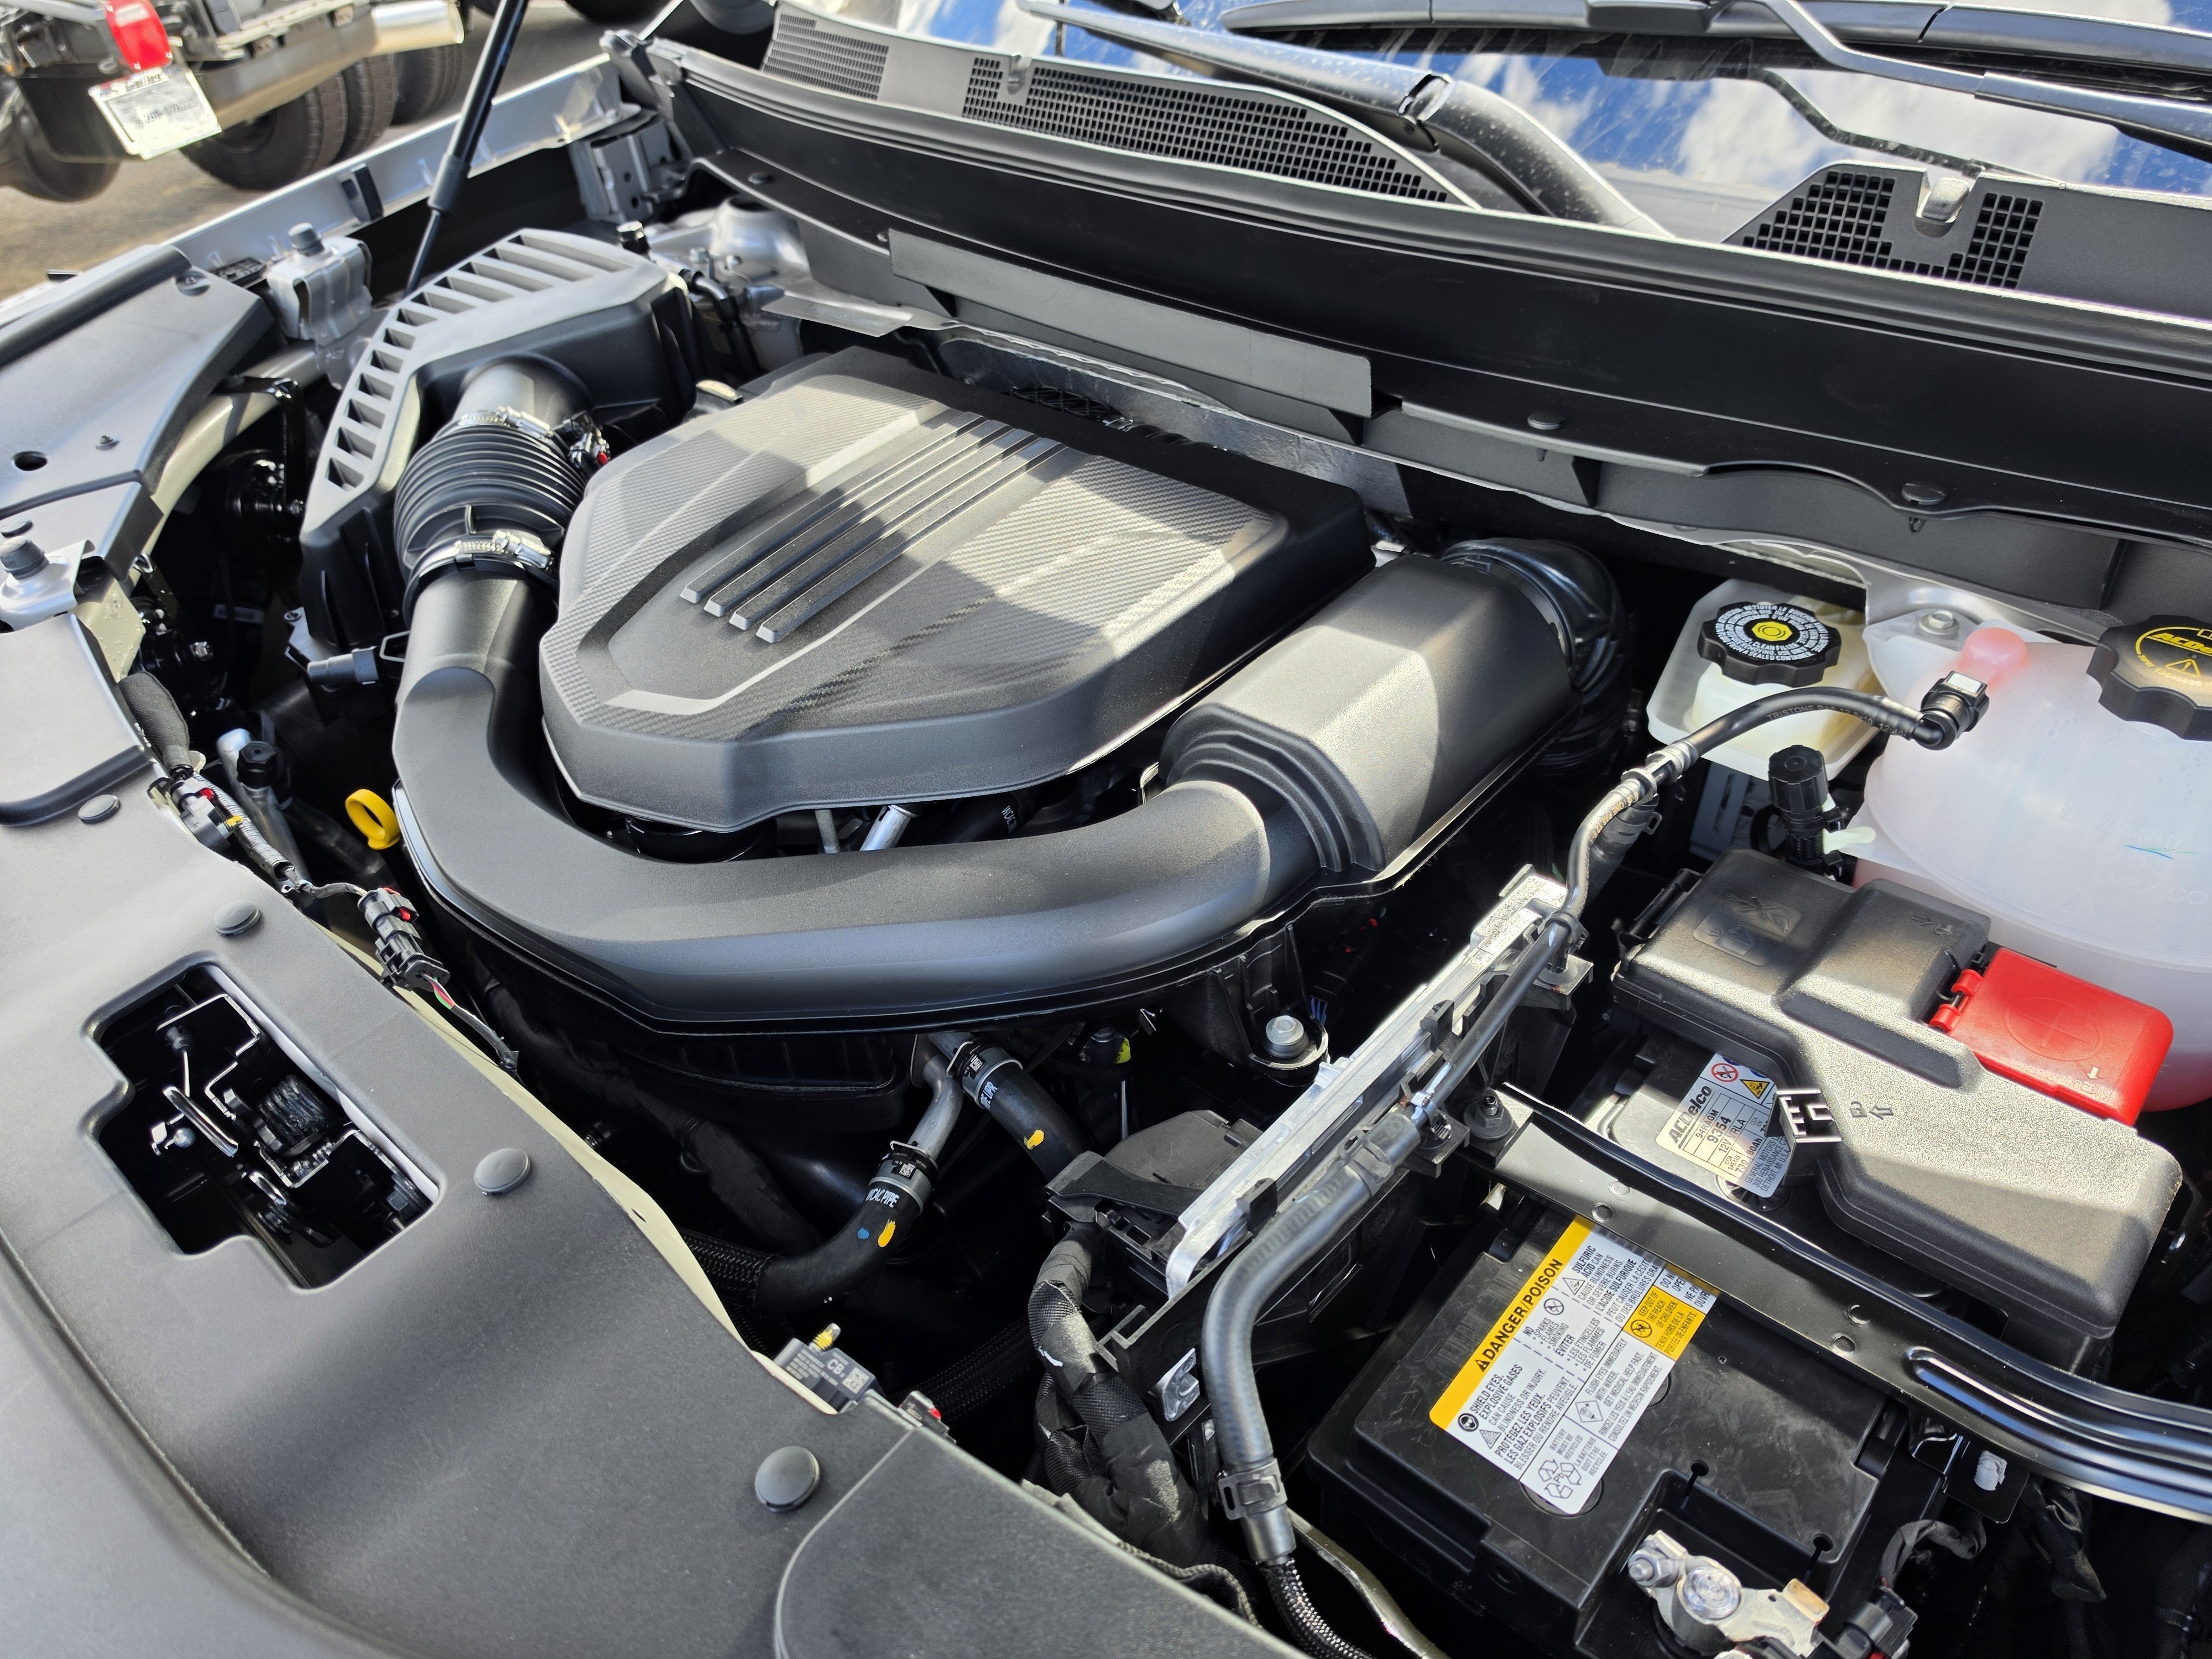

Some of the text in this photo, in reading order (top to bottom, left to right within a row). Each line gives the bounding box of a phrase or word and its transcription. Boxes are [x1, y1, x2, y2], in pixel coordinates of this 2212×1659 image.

[1747, 651, 1775, 660] SEALED
[1766, 705, 1814, 721] TRISTONE
[1001, 805, 1016, 825] WCAC
[983, 1081, 998, 1099] UPR
[1670, 1086, 1712, 1143] ACDelco
[1695, 1109, 1719, 1138] 94RAGM
[1749, 1117, 1758, 1125] CCA
[1707, 1116, 1731, 1143] 9354
[1718, 1119, 1746, 1152] 12V VRLA
[1746, 1138, 1762, 1155] 80Ah
[1724, 1155, 1733, 1165] CCA
[1728, 1155, 1740, 1171] SAE/GS
[1734, 1159, 1749, 1173] 730
[1744, 1161, 1764, 1183] GENERAL
[1758, 1140, 1776, 1161] MOTORS
[1752, 1177, 1764, 1188] 300
[1758, 1144, 1783, 1178] RENAISSANCE
[1760, 1169, 1780, 1192] DETROIT,
[880, 1190, 900, 1208] PIPE
[1572, 1245, 1596, 1273] SULFURIC
[1581, 1253, 1603, 1279] ACID CAN
[1578, 1255, 1614, 1300] CAUSE BLINDNESS
[1587, 1260, 1624, 1306] OR SEVERE BURNS.
[1595, 1259, 1636, 1311] L'ACIDE SULFURIQUE
[1660, 1278, 1671, 1288] DO
[1606, 1301, 1620, 1317] PEUT
[1616, 1282, 1635, 1303] CAUSER
[1629, 1275, 1640, 1284] LA
[1615, 1264, 1659, 1322] OU DES BRÛLURES GRA
[1639, 1305, 1649, 1316] KEEP
[1645, 1296, 1655, 1307] OUT
[1684, 1291, 1695, 1301] NE
[1694, 1291, 1710, 1307] OUVR
[1481, 1258, 1563, 1361] DANGER/POISON
[1647, 1300, 1666, 1321] THE REACH
[1660, 1301, 1678, 1322] CHILDREN.
[1679, 1312, 1697, 1333] ENFANTS.
[1522, 1326, 1534, 1337] NO
[1533, 1317, 1552, 1338] SPARKS
[1541, 1321, 1559, 1342] FLAMES
[1548, 1322, 1569, 1347] SMOKING
[1567, 1318, 1600, 1359] LES ÉTINCELLES
[1655, 1335, 1668, 1349] TENIR
[1665, 1323, 1676, 1335] HORS
[1671, 1317, 1681, 1326] DE
[1675, 1331, 1684, 1339] DE
[1553, 1334, 1575, 1357] ÉVITER
[1575, 1327, 1605, 1364] LES FLAMMES
[1583, 1341, 1606, 1369] DE FUMER
[1585, 1338, 1627, 1395] FLUSH EYES IMMEDIATELY
[1603, 1352, 1644, 1407] GET MEDICAL HELP FAST.
[1470, 1374, 1504, 1413] SHIELD EYES.
[1478, 1364, 1522, 1420] EXPLOSIVE GASES
[1594, 1371, 1619, 1401] WITH WATER.
[1488, 1392, 1516, 1426] CAN CAUSE
[1497, 1368, 1546, 1432] BLINDNESS OR INJURY.
[1494, 1392, 1546, 1457] PROTÉGEZ LES YEUX.
[1504, 1376, 1569, 1464] LES GAZ EXPLOSIFS PEUVENT
[1514, 1383, 1578, 1470] BLESSER OU RENDRE AVEUGLE.
[1598, 1418, 1614, 1436] RINCEZ
[1608, 1410, 1619, 1421] LES
[1614, 1399, 1626, 1412] YEUX
[1608, 1416, 1629, 1442] CONSULTEZ
[1623, 1410, 1633, 1418] UN
[1549, 1428, 1566, 1451] BATTERY
[1556, 1433, 1574, 1455] MUST BE
[1563, 1435, 1583, 1460] RECYCLED
[1573, 1436, 1597, 1467] LA BATTERIE
[1580, 1458, 1592, 1472] DOIT
[1588, 1451, 1608, 1476] RECYCLÉE
[1553, 1472, 1566, 1484] Pb
